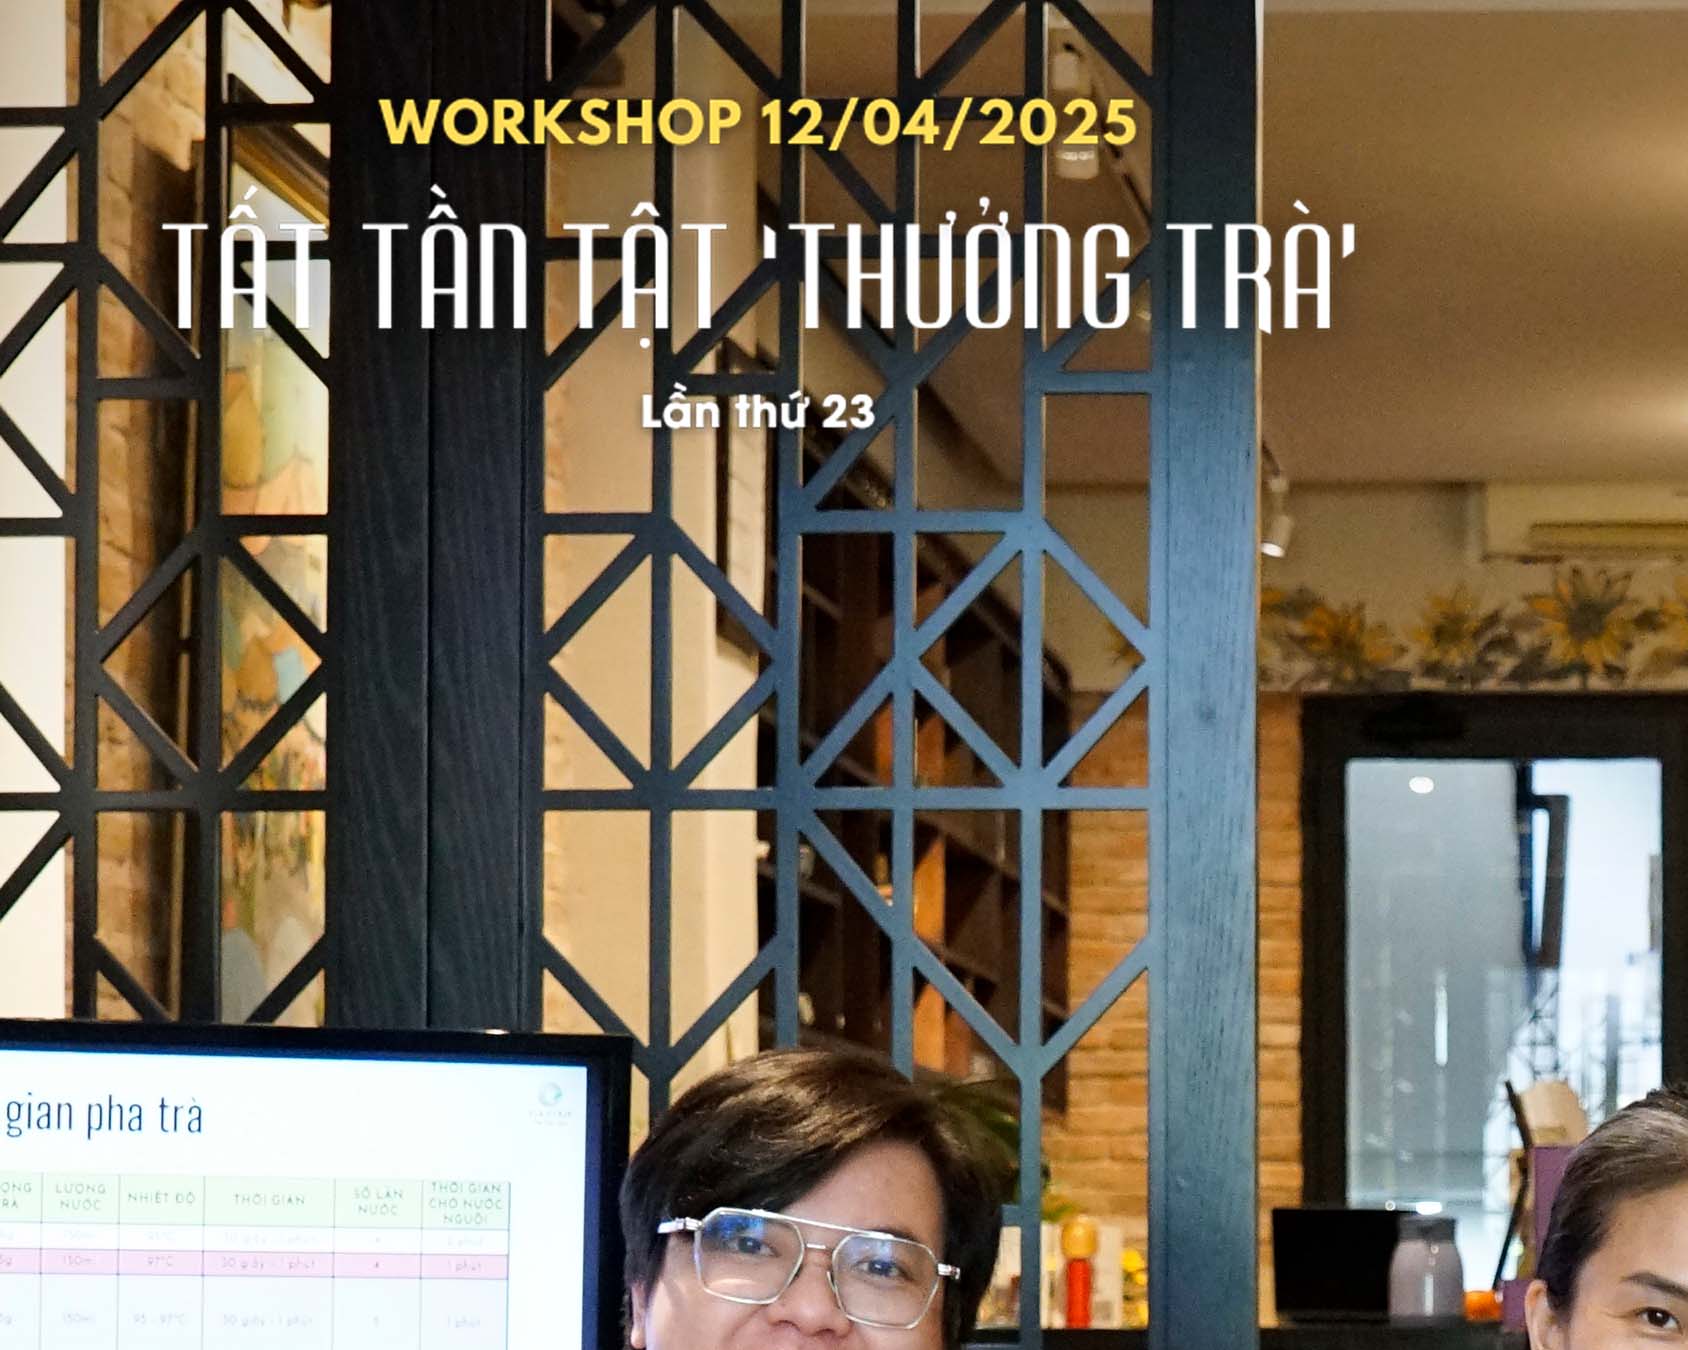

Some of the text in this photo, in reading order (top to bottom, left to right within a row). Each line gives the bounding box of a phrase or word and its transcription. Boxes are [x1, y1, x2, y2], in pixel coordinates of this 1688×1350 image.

[6, 1092, 204, 1141] gian pha trà
[468, 1182, 502, 1195] GIAN
[271, 1194, 305, 1206] GIAN
